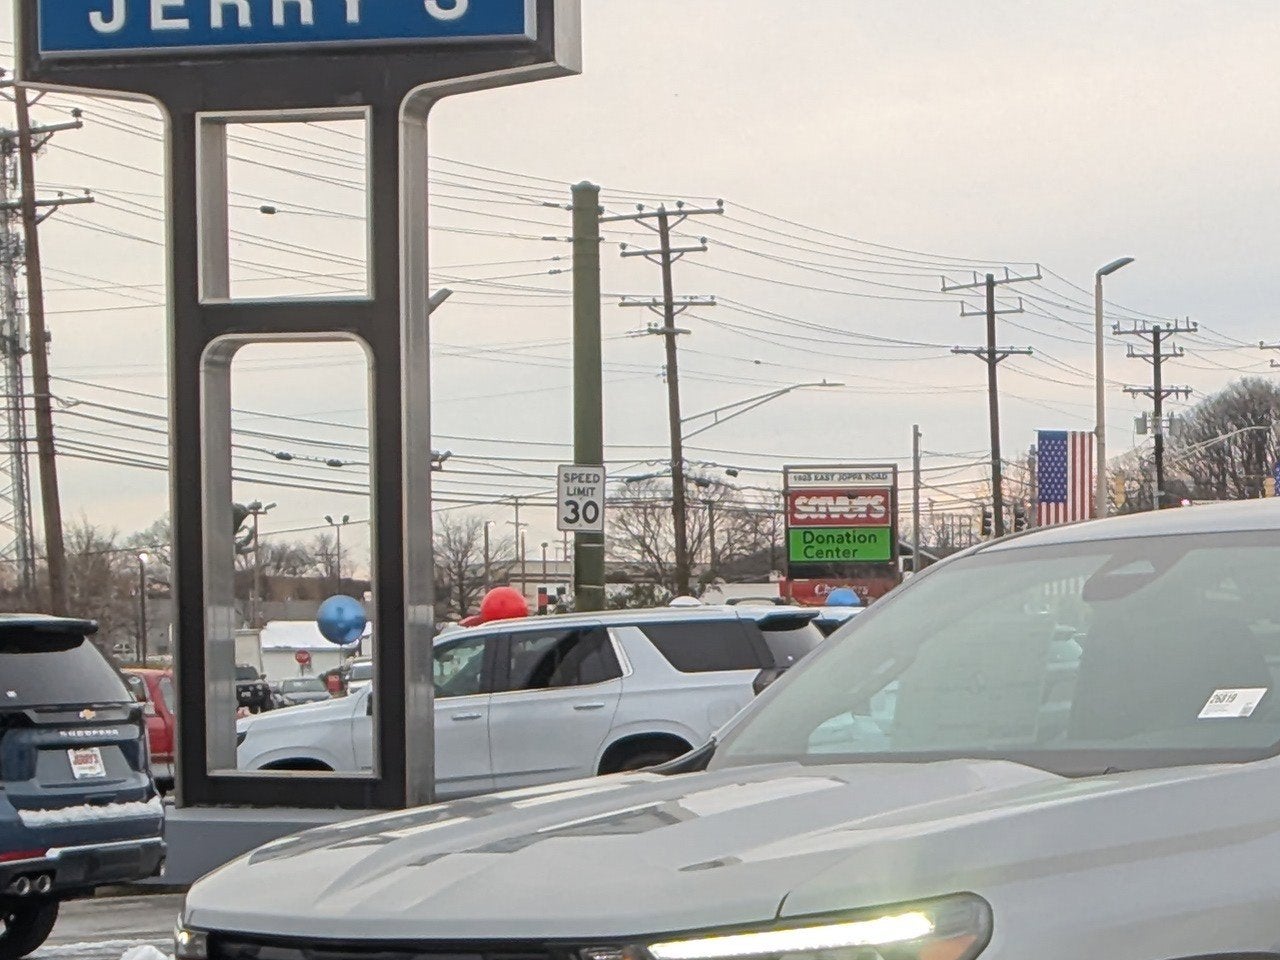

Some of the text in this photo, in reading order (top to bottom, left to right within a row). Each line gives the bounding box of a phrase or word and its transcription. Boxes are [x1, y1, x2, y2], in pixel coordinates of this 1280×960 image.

[563, 472, 600, 483] SPEED
[813, 472, 834, 482] EAST
[865, 472, 888, 481] ROAD
[566, 486, 596, 497] LIMIT
[563, 499, 599, 524] 30
[803, 530, 877, 545] Donation
[803, 545, 858, 559] Center
